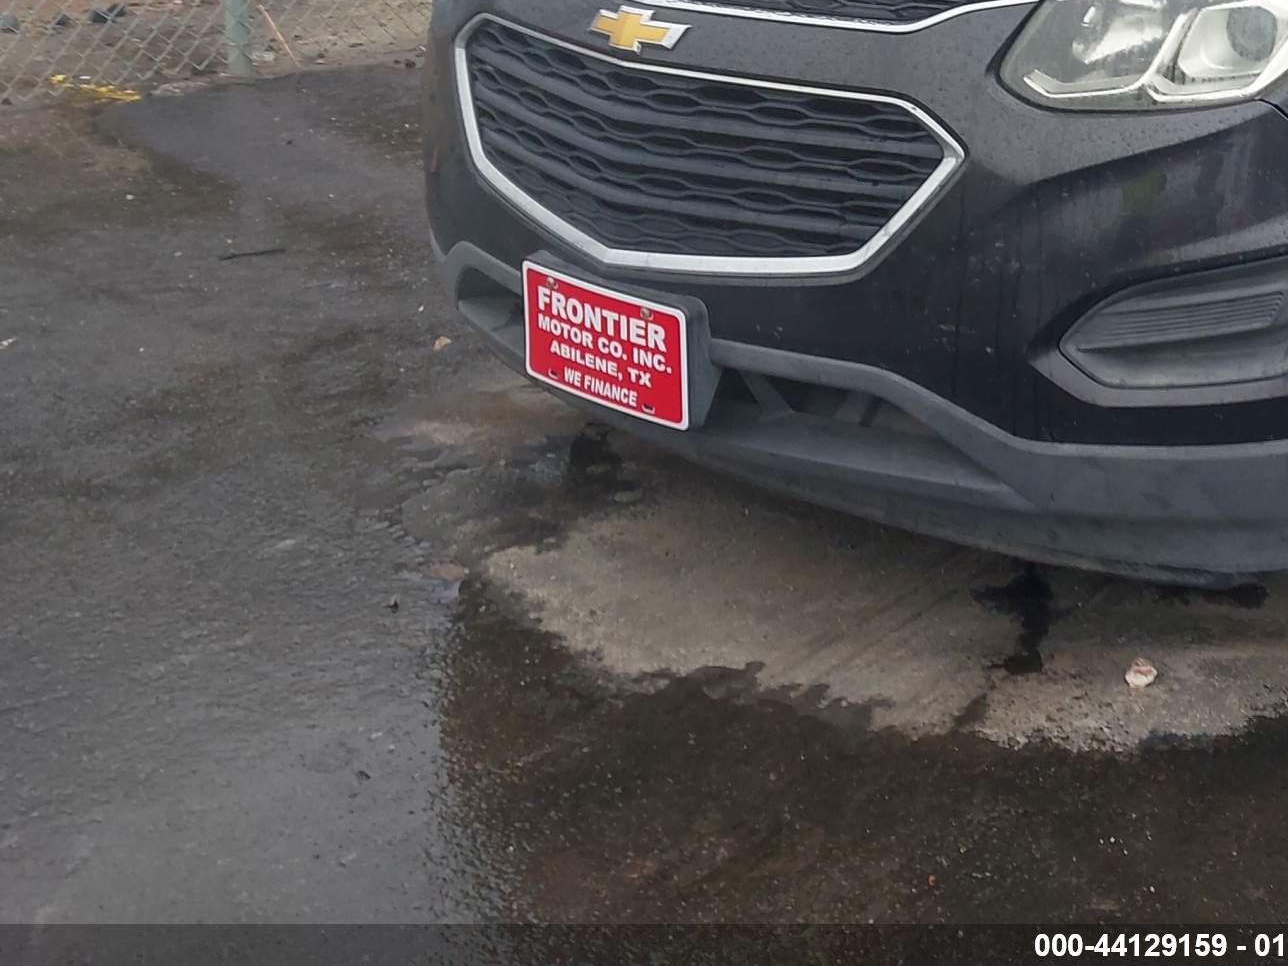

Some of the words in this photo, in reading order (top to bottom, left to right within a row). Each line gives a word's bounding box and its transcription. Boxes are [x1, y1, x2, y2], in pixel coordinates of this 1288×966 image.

[537, 285, 667, 352] FRONTIER
[537, 314, 594, 349] MOTOR
[597, 336, 628, 360] CO.
[633, 347, 673, 374] INC.
[549, 340, 623, 381] ABILENE,
[627, 367, 652, 387] TX
[563, 367, 581, 387] WE
[584, 374, 638, 406] FINANCE
